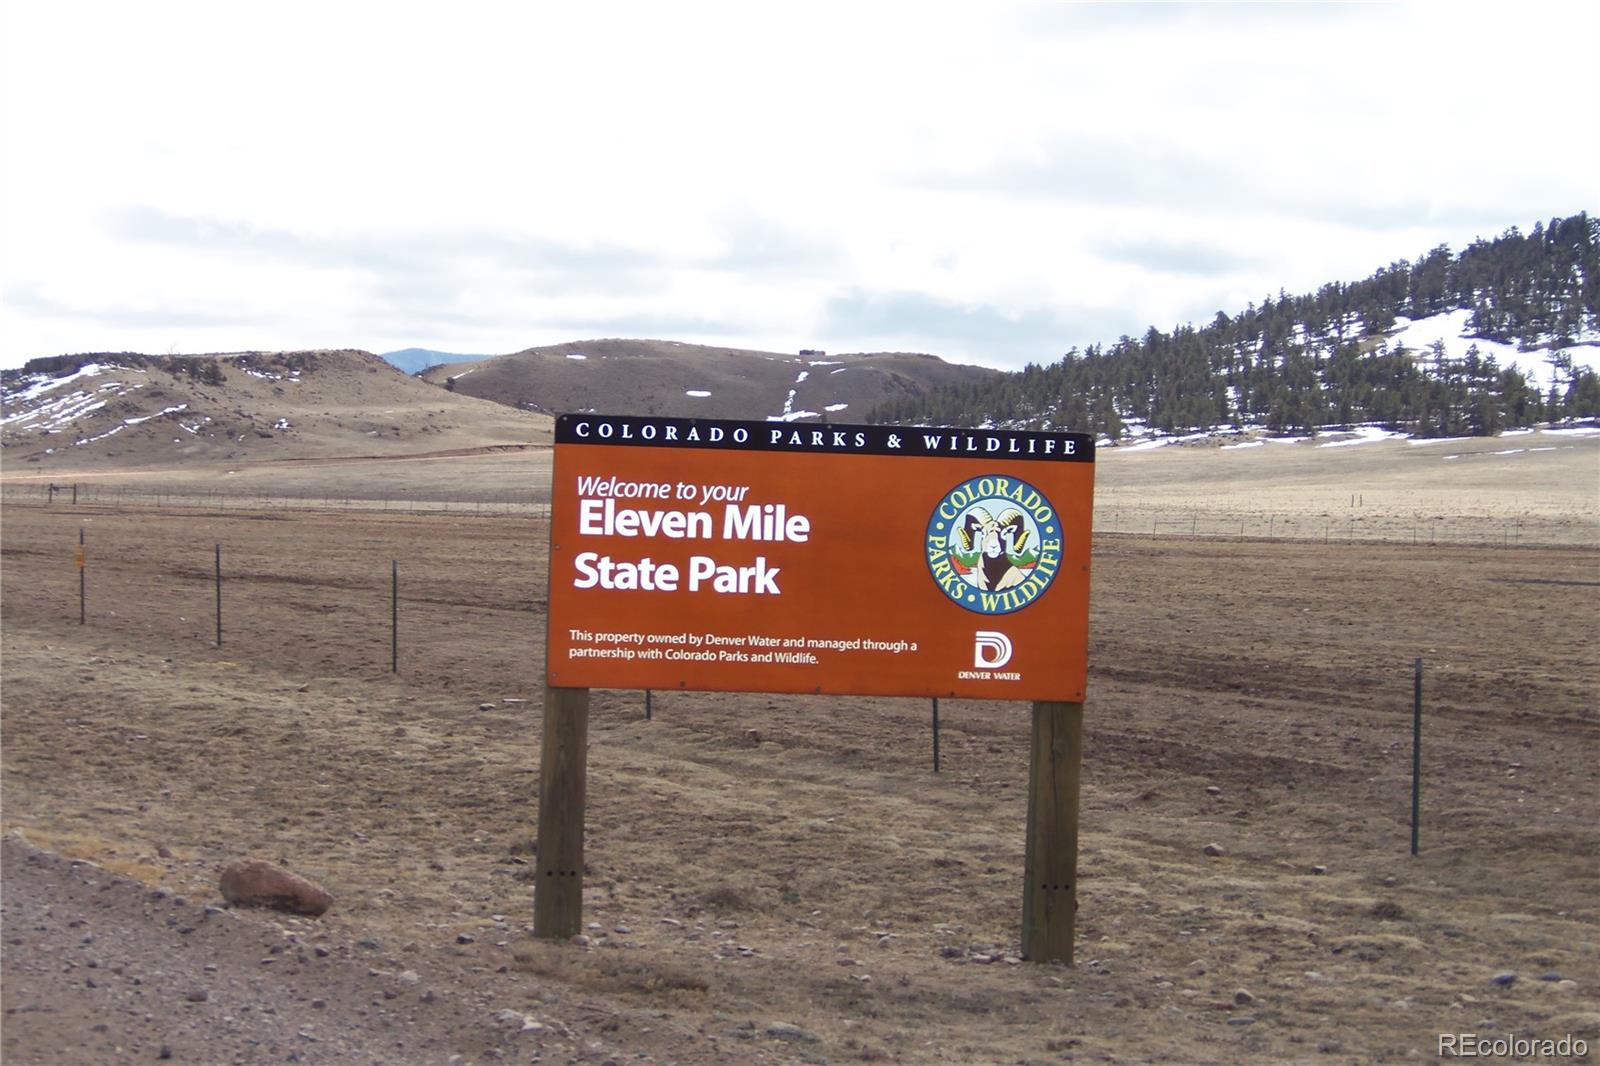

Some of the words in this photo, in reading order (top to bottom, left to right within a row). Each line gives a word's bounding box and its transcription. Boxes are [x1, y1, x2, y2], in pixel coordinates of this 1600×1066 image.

[576, 422, 748, 443] COLORADO
[770, 429, 865, 447] PARKS
[887, 433, 902, 448] &
[923, 435, 1075, 454] WILDLIFE
[577, 476, 671, 499] Welcome
[676, 482, 697, 500] to
[700, 484, 749, 505] your
[940, 478, 1053, 523] COLORADO
[579, 498, 713, 539] Eleven
[723, 504, 810, 542] Mile
[573, 552, 679, 591] State
[689, 556, 781, 594] Park
[928, 535, 967, 599] PARKS
[980, 538, 1060, 611] WILDLIFE
[569, 629, 593, 642] This
[595, 632, 645, 646] property
[647, 633, 687, 645] owned
[688, 633, 703, 646] by
[705, 634, 746, 646] Denver
[748, 635, 781, 647] Water
[783, 637, 805, 648] and
[807, 638, 861, 651] managed
[863, 639, 908, 652] through
[910, 642, 917, 651] a
[569, 647, 635, 660] partnership
[637, 648, 663, 660] with
[665, 648, 716, 662] Colorado
[719, 650, 749, 663] Parks
[751, 651, 773, 663] and
[775, 652, 819, 664] Wildlife.
[958, 671, 991, 680] DENVER
[993, 672, 1021, 681] WATER
